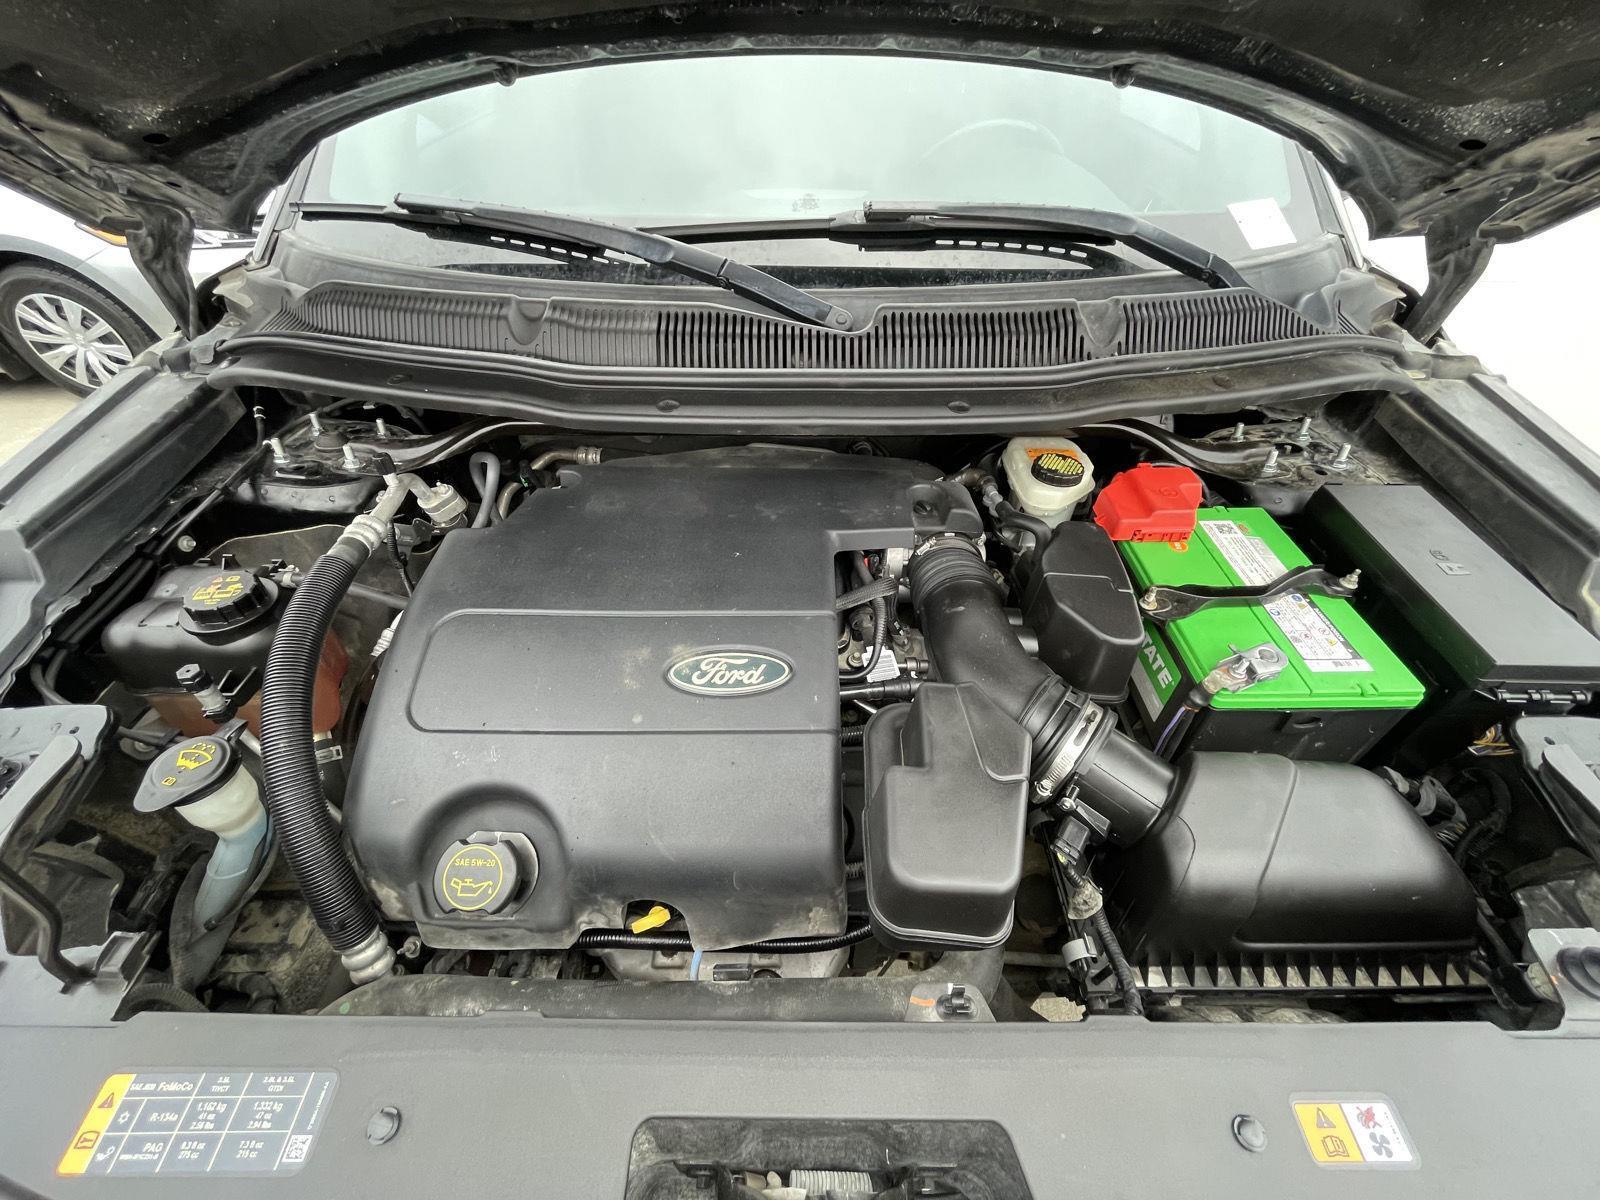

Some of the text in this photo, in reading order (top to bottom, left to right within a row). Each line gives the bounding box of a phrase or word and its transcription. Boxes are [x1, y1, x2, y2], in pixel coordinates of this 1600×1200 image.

[691, 657, 767, 685] Ford
[454, 858, 496, 867] SAE 5W-20
[157, 1082, 194, 1091] FoMoCo
[198, 1102, 228, 1113] 1.162 kg
[253, 1101, 284, 1113] 1.332 kg
[150, 1112, 179, 1122] R-134a
[143, 1142, 164, 1153] PAG
